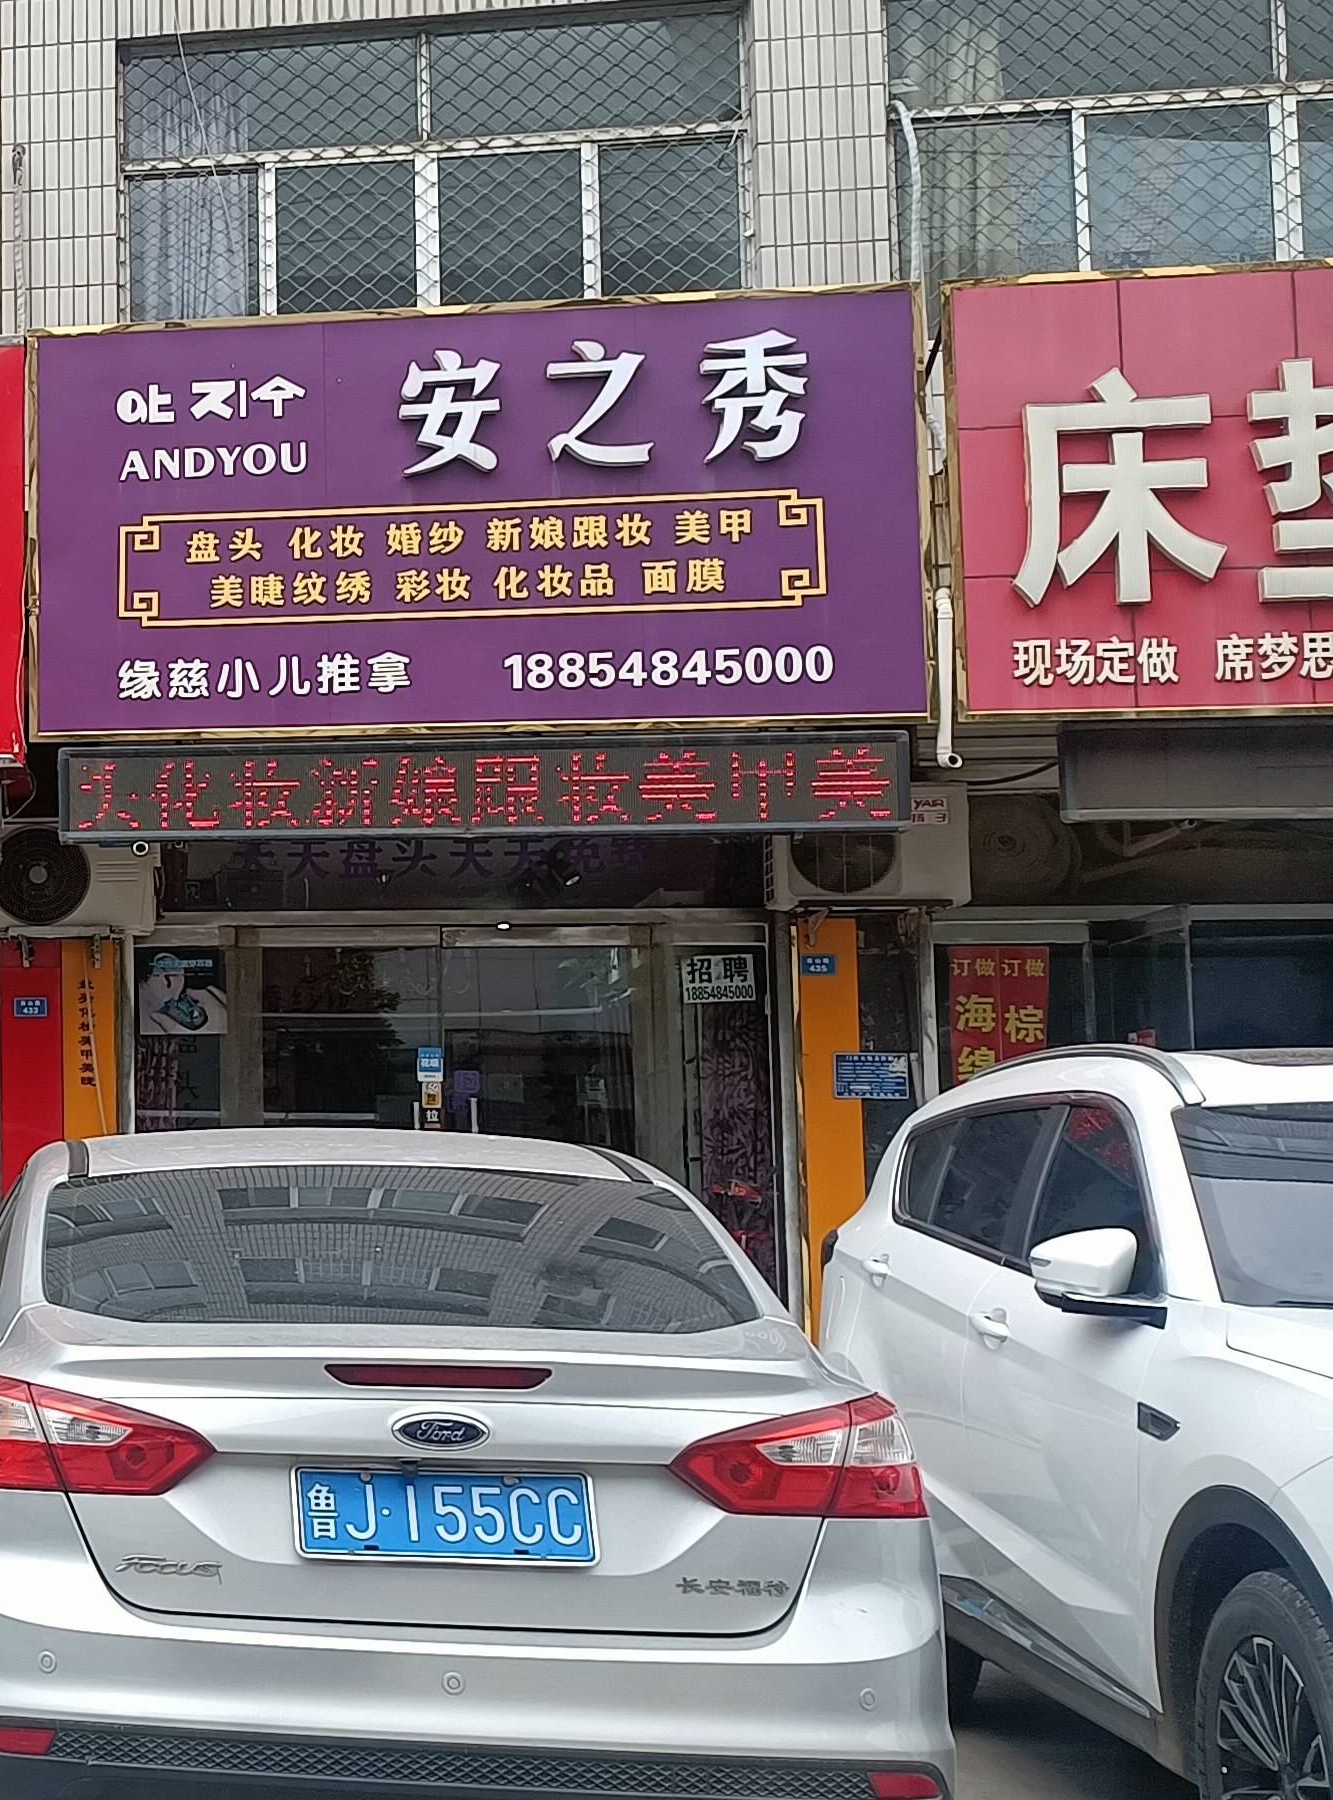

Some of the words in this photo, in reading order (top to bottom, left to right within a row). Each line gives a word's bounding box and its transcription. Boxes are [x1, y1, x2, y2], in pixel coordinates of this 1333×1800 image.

[399, 329, 808, 479] 安之秀
[119, 440, 309, 482] ANDYOU
[185, 528, 264, 565] 盘头
[287, 524, 366, 561] 化妆
[385, 520, 466, 557] 婚纱
[485, 513, 653, 554] 新娘跟妆
[673, 508, 754, 545] 美甲
[208, 570, 373, 610] 美睫纹绣
[395, 566, 472, 602] 彩妆
[493, 561, 616, 600] 化妆品
[641, 557, 726, 595] 面膜
[116, 648, 413, 702] 缘慈小儿推拿
[501, 644, 835, 691] 18854845000
[1012, 636, 1181, 687] 现场定做
[1214, 630, 1333, 683] 席梦思
[685, 956, 750, 985] 招聘
[950, 957, 997, 979] 订做
[1001, 957, 1047, 979] 订做
[685, 984, 754, 1002] 18854845000
[955, 993, 997, 1082] 海绵
[1004, 1004, 1046, 1045] 棕
[416, 1420, 465, 1443] Ford
[675, 1576, 790, 1598] 长安福特
